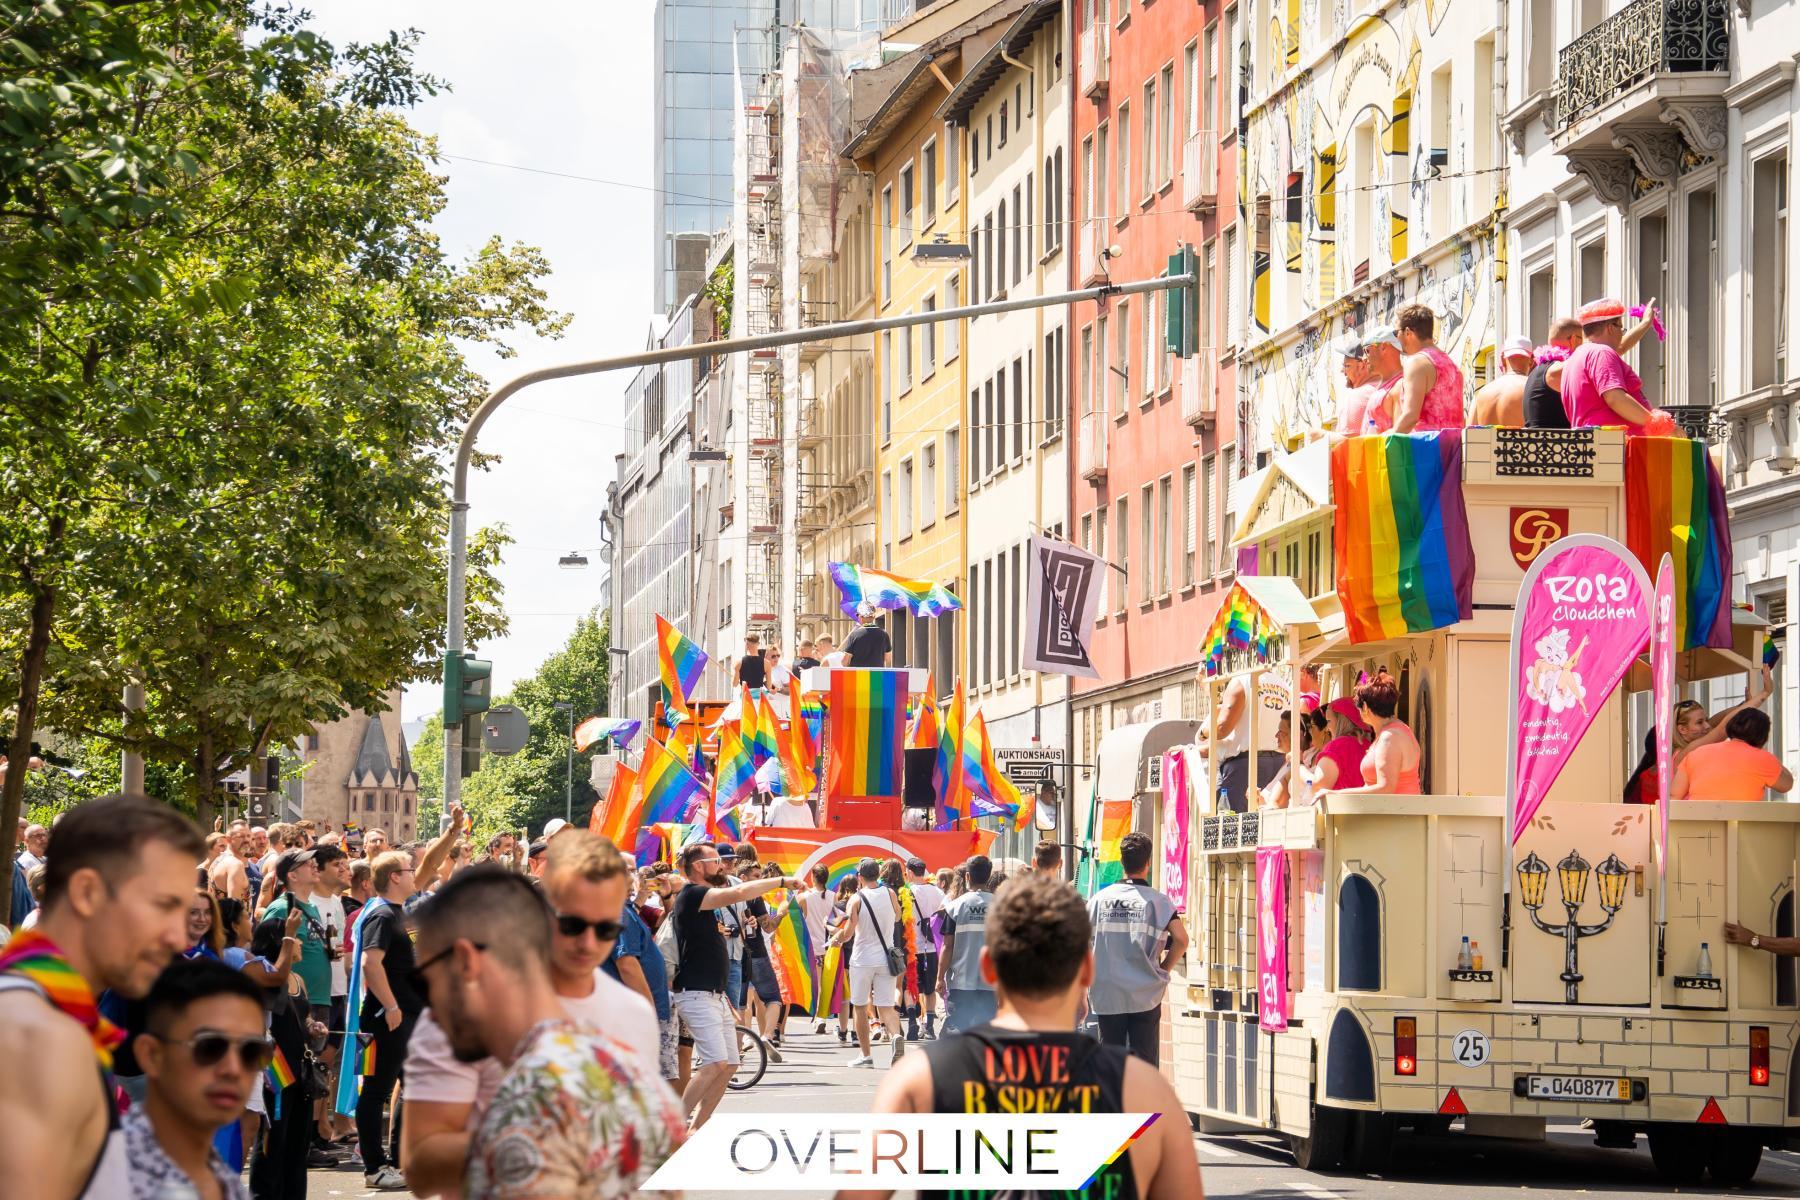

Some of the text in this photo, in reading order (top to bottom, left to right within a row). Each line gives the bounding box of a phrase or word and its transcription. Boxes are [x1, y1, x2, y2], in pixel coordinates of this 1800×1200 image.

[1544, 573, 1628, 604] Rosa
[1552, 603, 1636, 622] Cloudchen
[1264, 696, 1284, 711] CSD
[998, 750, 1061, 760] AUKTIONSHAUS
[1458, 1036, 1484, 1061] 25
[984, 1044, 1071, 1084] LOVE
[1530, 1077, 1615, 1098] F 040877
